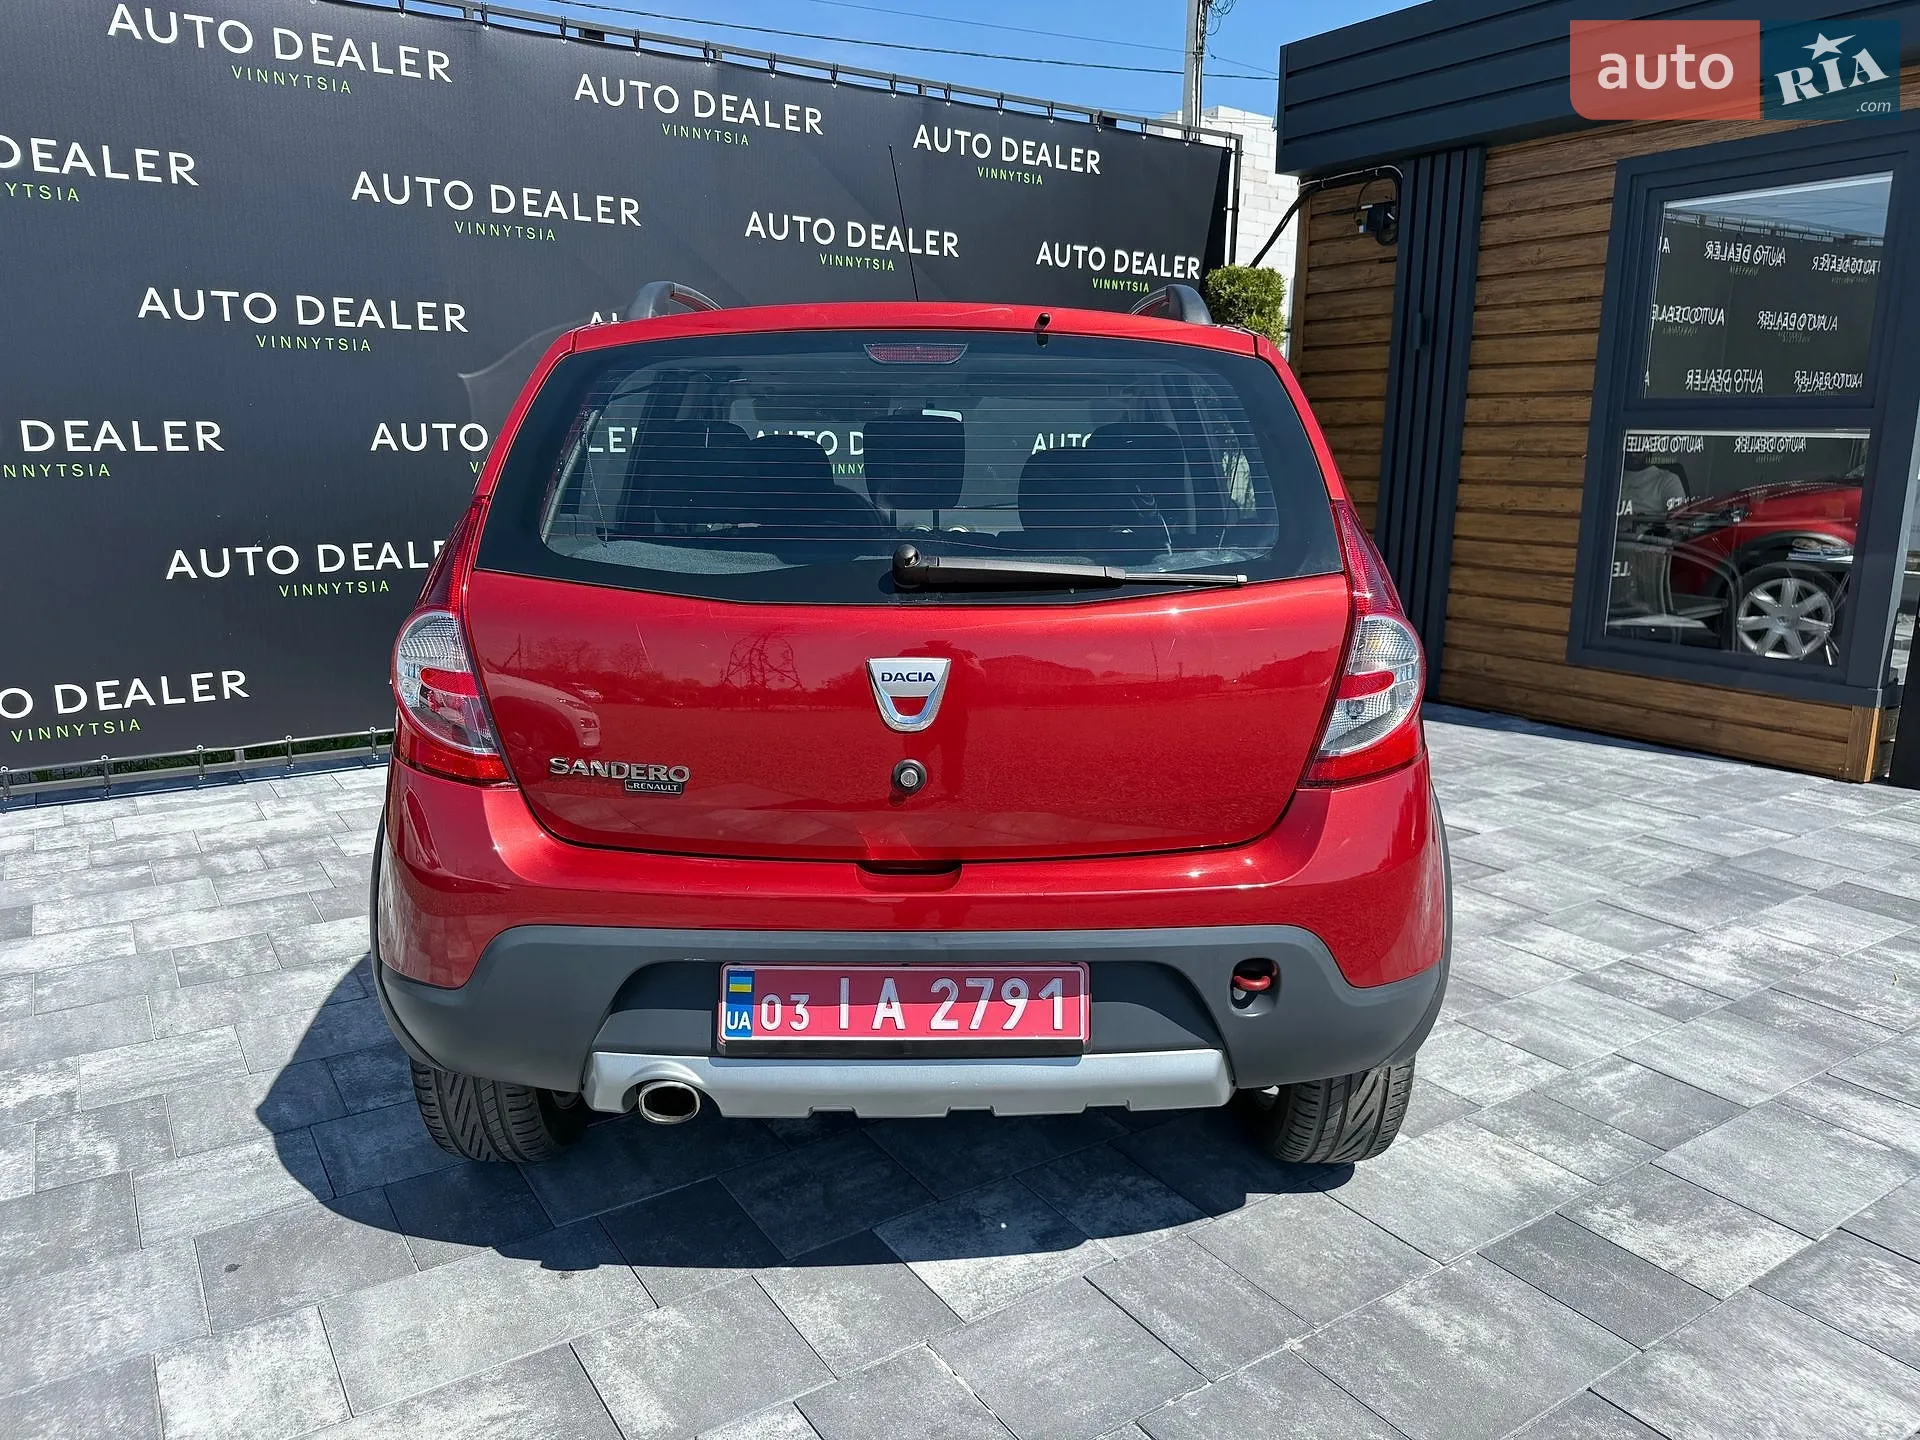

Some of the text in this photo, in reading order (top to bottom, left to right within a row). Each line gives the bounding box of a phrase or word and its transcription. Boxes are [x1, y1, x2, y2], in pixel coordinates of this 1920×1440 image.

[108, 4, 452, 83] AUTO DEALER
[232, 65, 352, 94] VINNYTSIA
[575, 74, 823, 135] AUTO DEALER
[661, 123, 749, 146] VINNYTSIA
[913, 125, 1100, 174] AUTO DEALER
[977, 167, 1043, 185] VINNYTSIA
[352, 171, 642, 226] AUTO DEALER
[455, 221, 555, 241] VINNYTSIA
[745, 211, 959, 258] AUTO DEALER
[820, 253, 894, 271] VINNYTSIA
[1035, 242, 1200, 280] AUTO DEALER
[1092, 278, 1149, 293] VINNYTSIA
[138, 287, 468, 333] AUTO DEALER
[256, 335, 371, 352] VINNYTSIA
[21, 420, 224, 452] DEALER
[371, 423, 488, 452] AUTO
[166, 541, 445, 580] AUTO DEAL
[279, 581, 389, 597] VINNYTSIA
[881, 672, 936, 682] DACIA
[55, 670, 250, 715] DEALER
[11, 719, 141, 743] VINNYTSIA
[549, 757, 690, 782] SANDERO
[633, 783, 678, 791] RENAULT
[760, 994, 810, 1030] 03
[930, 977, 1063, 1030] 2791
[727, 1010, 752, 1030] UA
